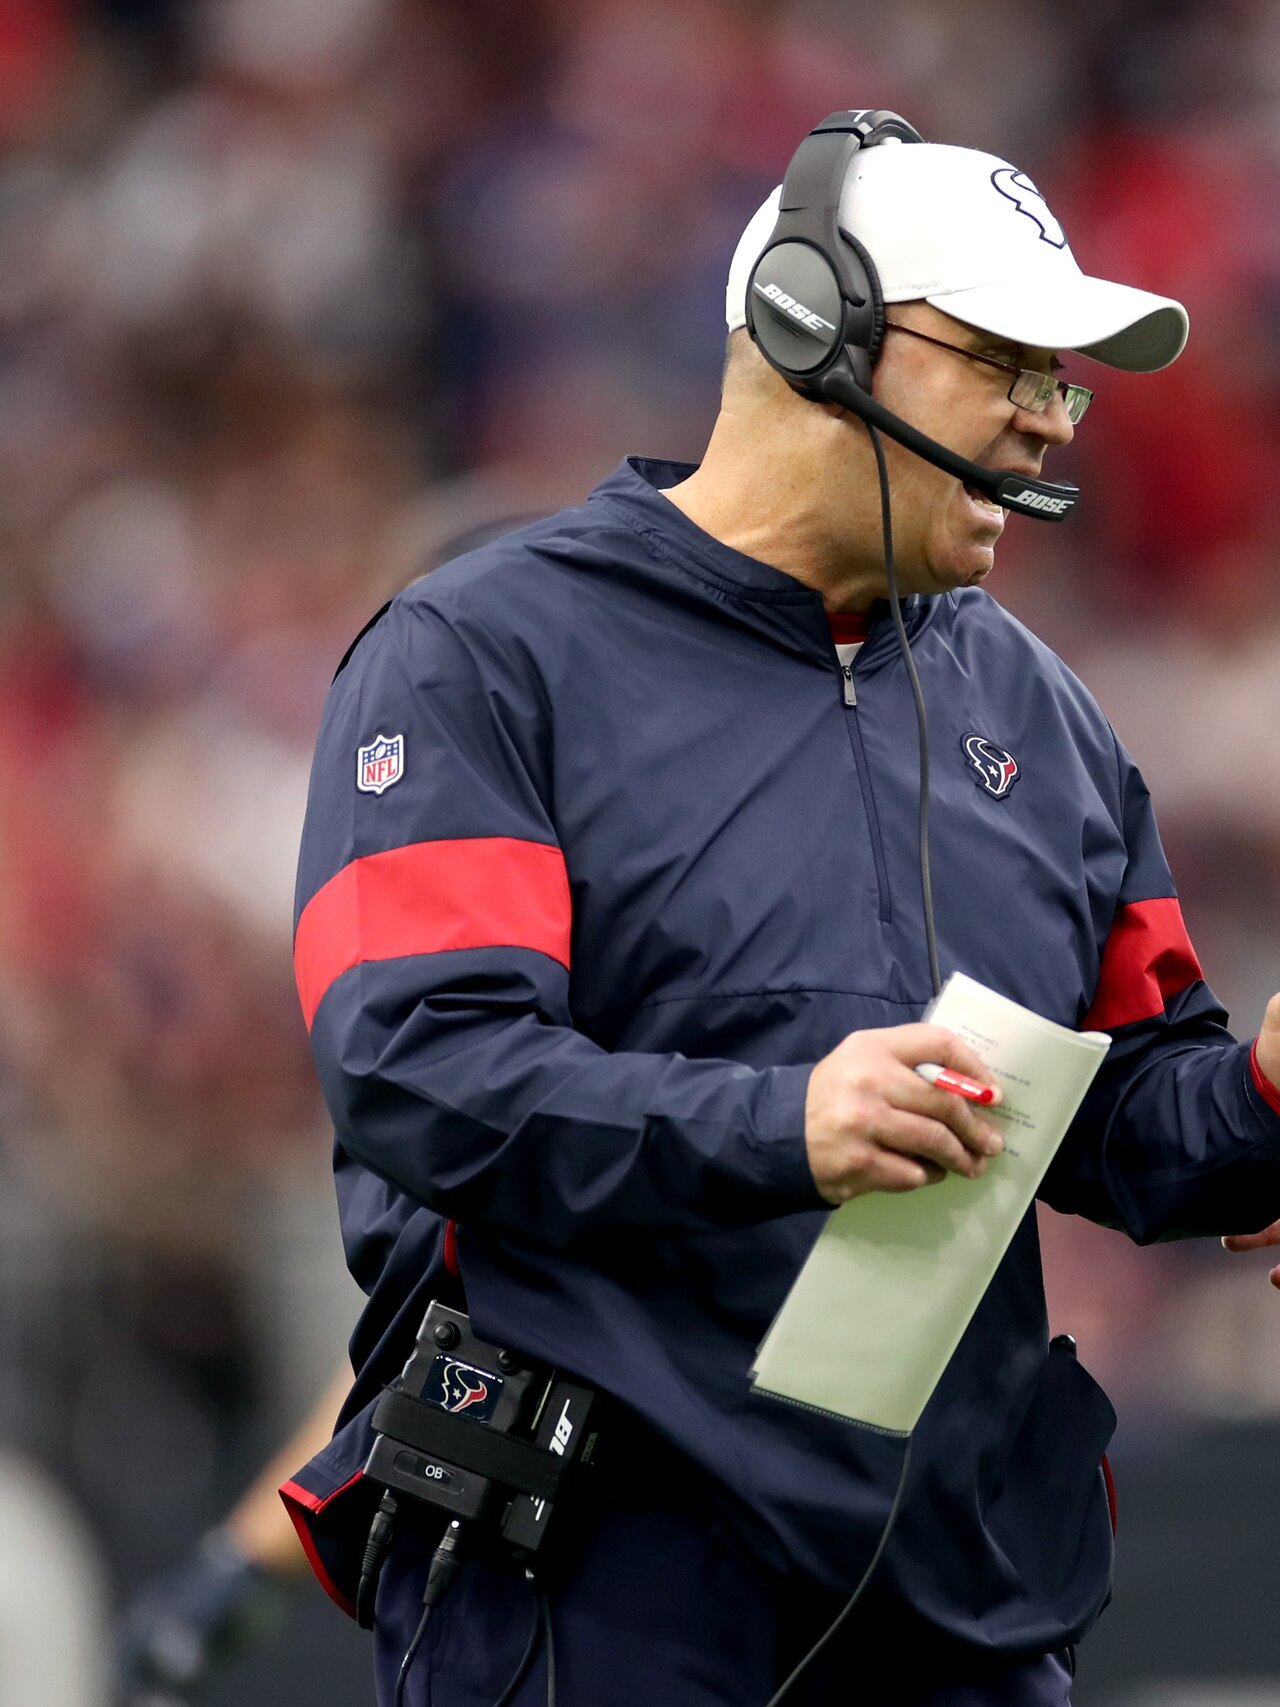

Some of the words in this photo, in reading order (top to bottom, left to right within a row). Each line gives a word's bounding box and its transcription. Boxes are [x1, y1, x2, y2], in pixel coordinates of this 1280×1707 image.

[754, 282, 836, 331] BOSE
[1002, 489, 1075, 514] BOSE
[365, 757, 396, 783] NFL
